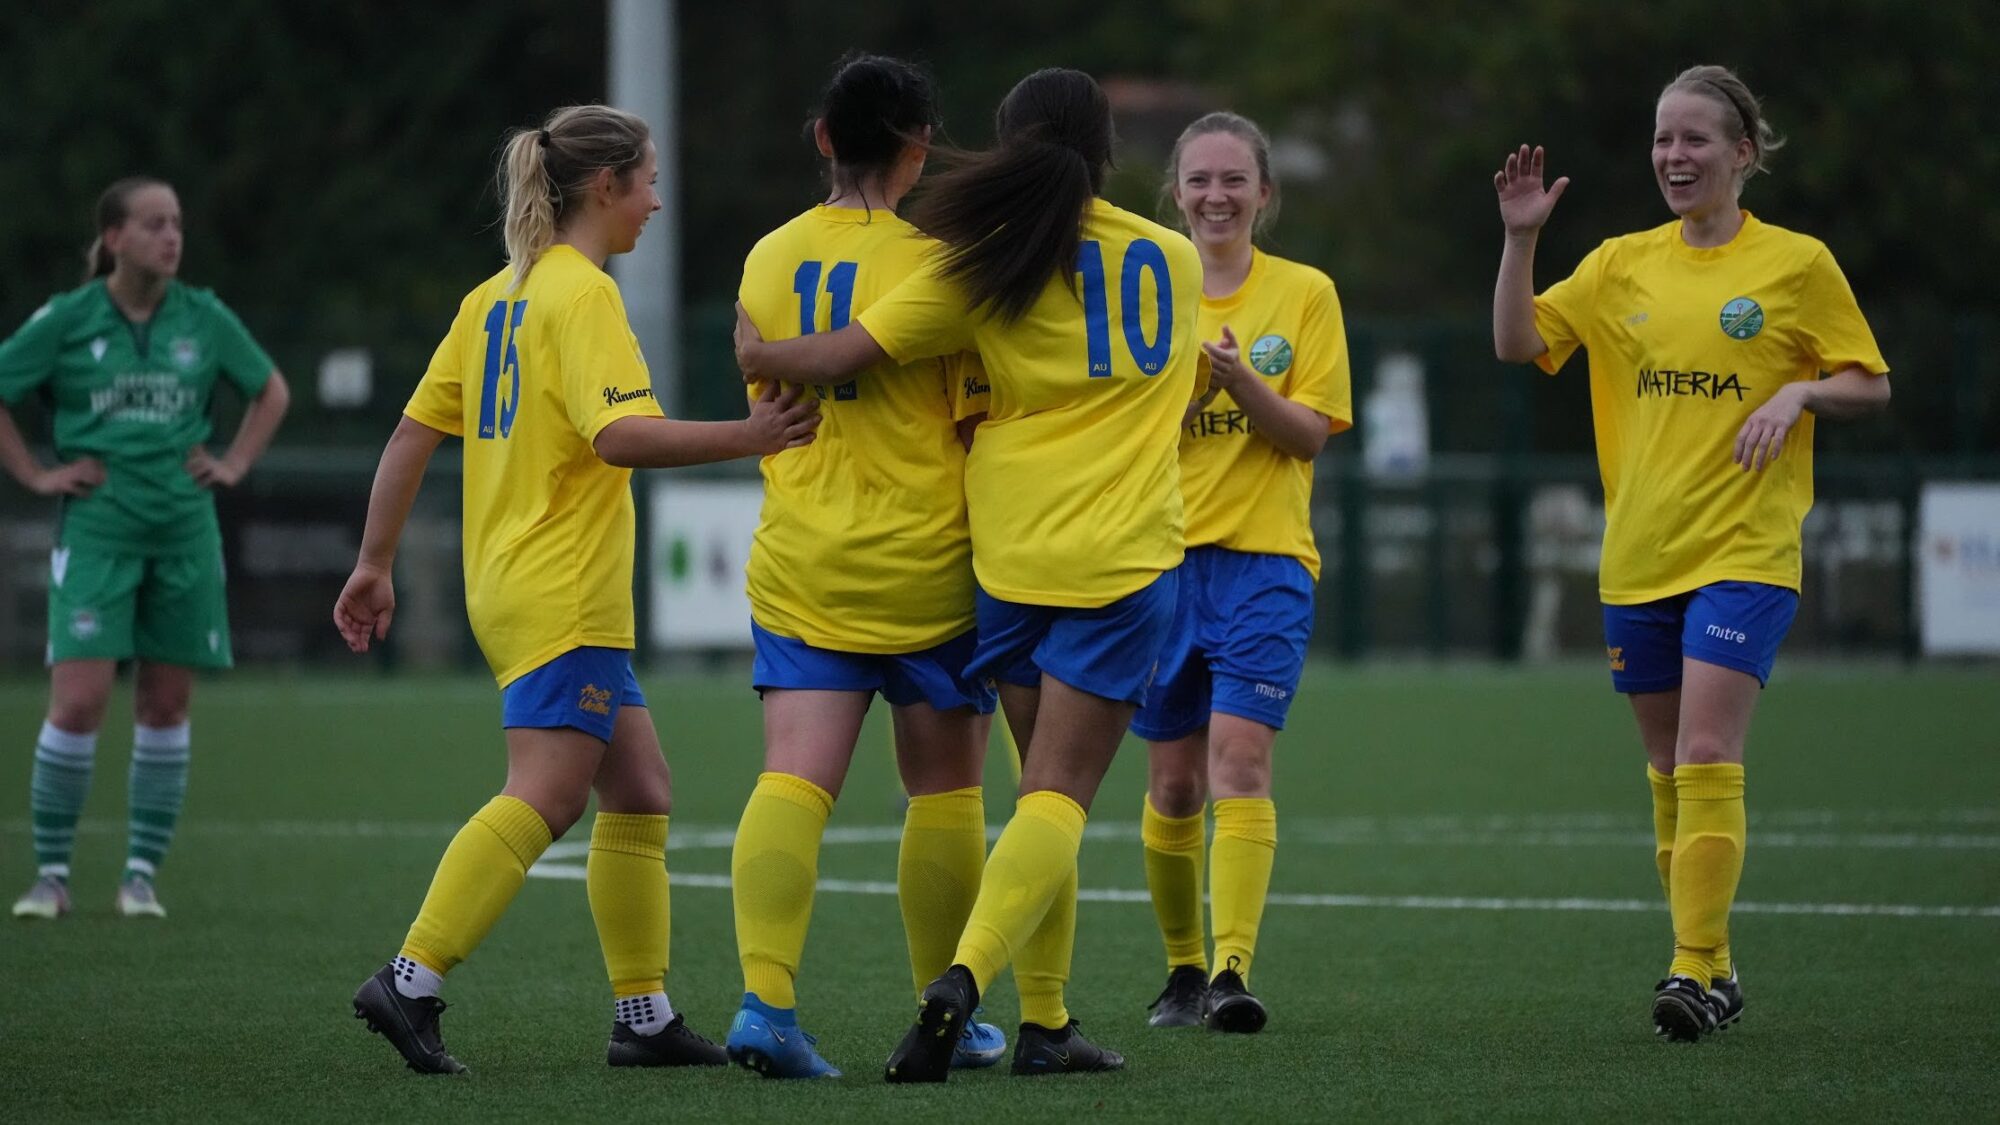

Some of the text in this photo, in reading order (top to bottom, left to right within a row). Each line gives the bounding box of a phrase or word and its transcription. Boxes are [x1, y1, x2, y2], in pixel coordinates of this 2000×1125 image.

[793, 260, 858, 337] 11
[1074, 238, 1173, 377] 10
[478, 299, 528, 439] 15
[1093, 363, 1108, 372] AU
[1637, 367, 1752, 402] MATERIA
[1706, 624, 1746, 643] mitre
[1255, 683, 1287, 700] mitre
